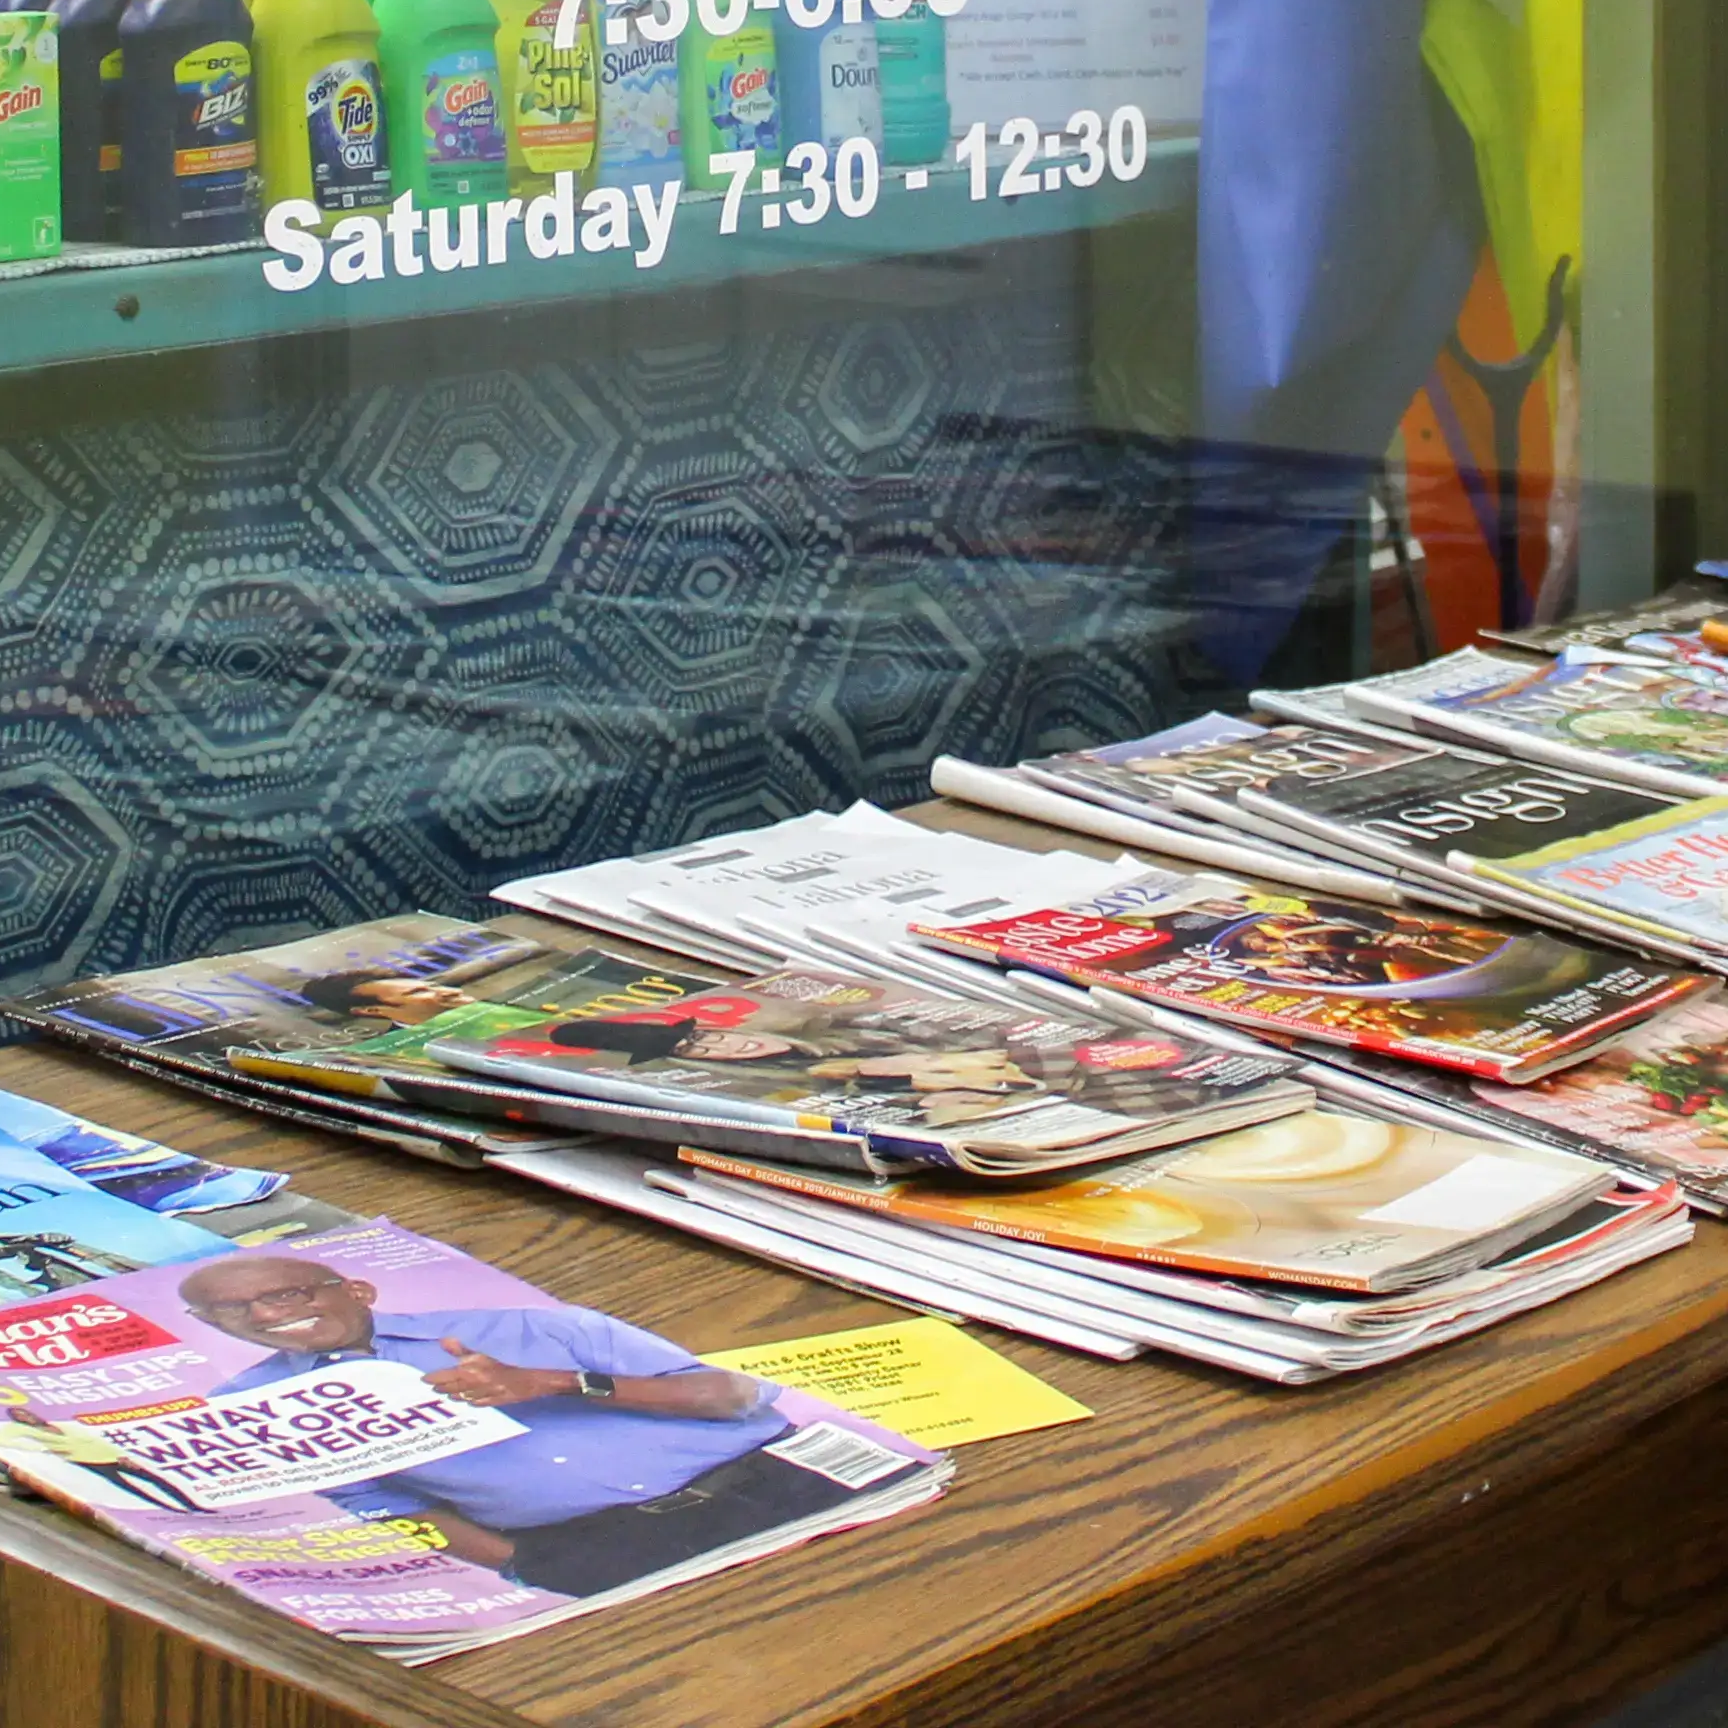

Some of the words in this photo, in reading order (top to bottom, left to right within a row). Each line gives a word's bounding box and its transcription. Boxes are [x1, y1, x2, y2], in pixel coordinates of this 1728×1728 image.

[601, 40, 677, 86] Suavitel
[199, 83, 248, 123] BIZ
[308, 77, 340, 106] 99%
[444, 78, 490, 115] Gain
[533, 72, 582, 110] Sol
[730, 67, 769, 100] Gain
[337, 93, 374, 136] Tide
[342, 143, 376, 168] OXI
[261, 169, 683, 293] Saturday
[708, 137, 879, 236] 7:30
[955, 104, 1148, 201] 12:30
[1132, 735, 1373, 798] nsign
[1348, 768, 1590, 849] nsign
[1557, 848, 1696, 892] Better
[690, 1151, 735, 1175] WOMAN'S
[734, 1163, 753, 1178] DAY
[754, 1168, 805, 1191] DECEMBER
[972, 1218, 1021, 1239] HOLIDAY
[1020, 1226, 1047, 1243] JOY!
[1266, 1270, 1359, 1291] WOMANSDAY.COM
[9, 1366, 112, 1393] EASY
[117, 1347, 211, 1374] TIPS
[29, 1371, 187, 1408] INSIDE!
[167, 1400, 280, 1437] WAY
[277, 1380, 358, 1409] TO
[126, 1424, 286, 1467] WALK
[288, 1390, 395, 1433] OFF
[158, 1449, 268, 1483] THE
[252, 1398, 460, 1465] WEIGHT
[301, 1517, 440, 1550] Sleep,
[311, 1529, 453, 1565] Energy
[347, 1554, 450, 1582] SMART
[456, 1587, 538, 1616] PAIN
